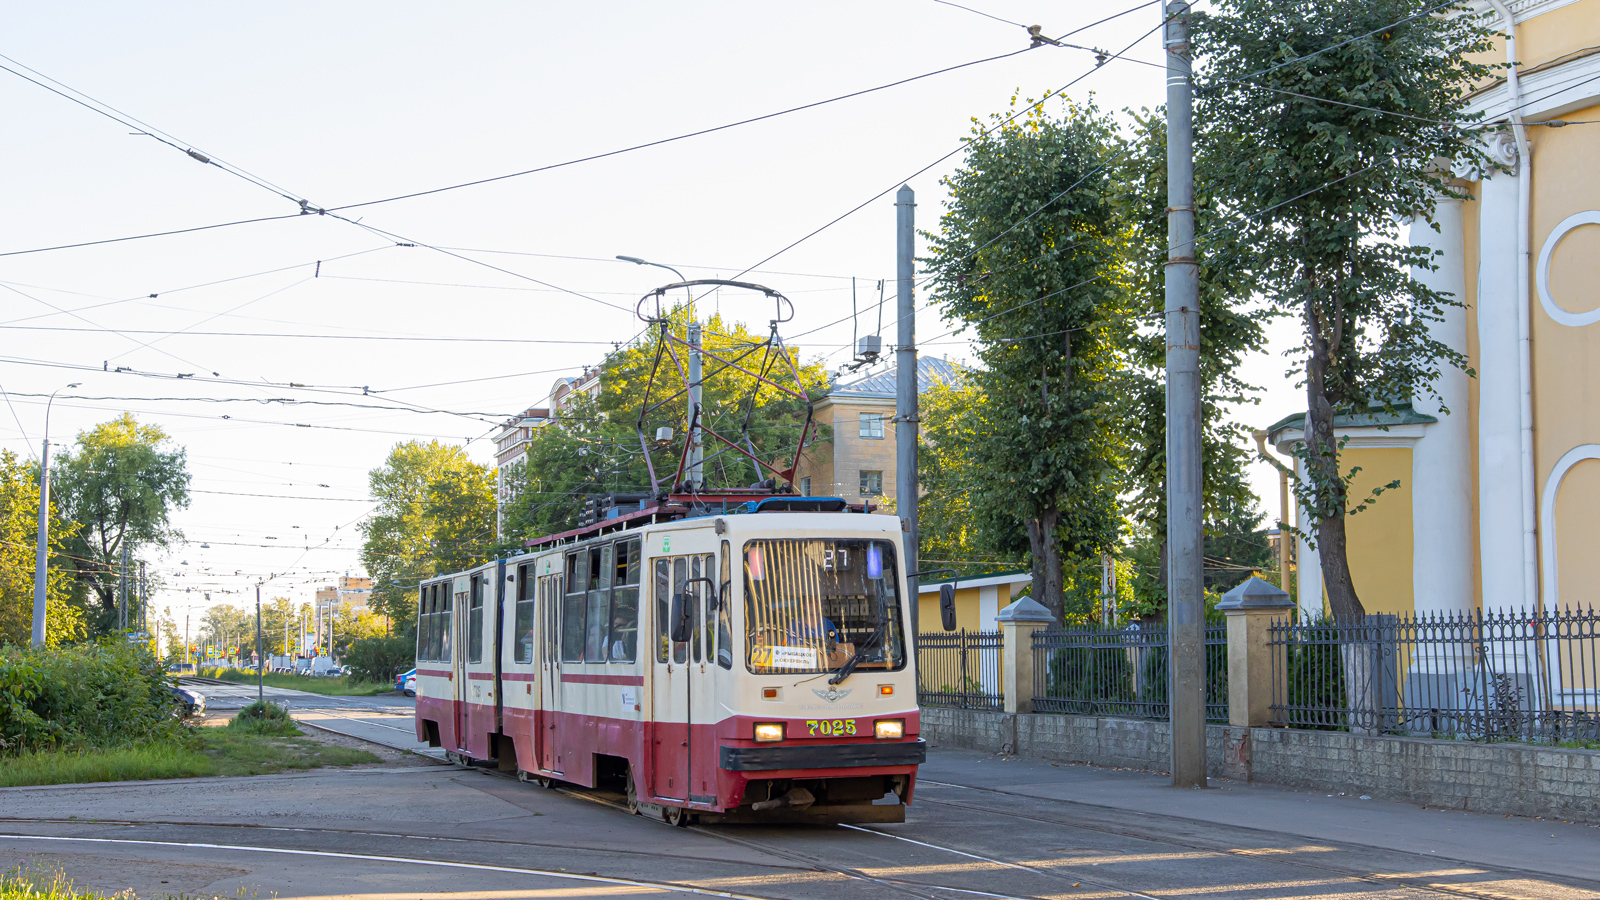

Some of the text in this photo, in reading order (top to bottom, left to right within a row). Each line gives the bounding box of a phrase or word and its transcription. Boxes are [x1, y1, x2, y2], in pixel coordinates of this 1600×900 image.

[824, 549, 847, 567] 27
[752, 647, 772, 664] 27
[806, 719, 857, 737] 7025
